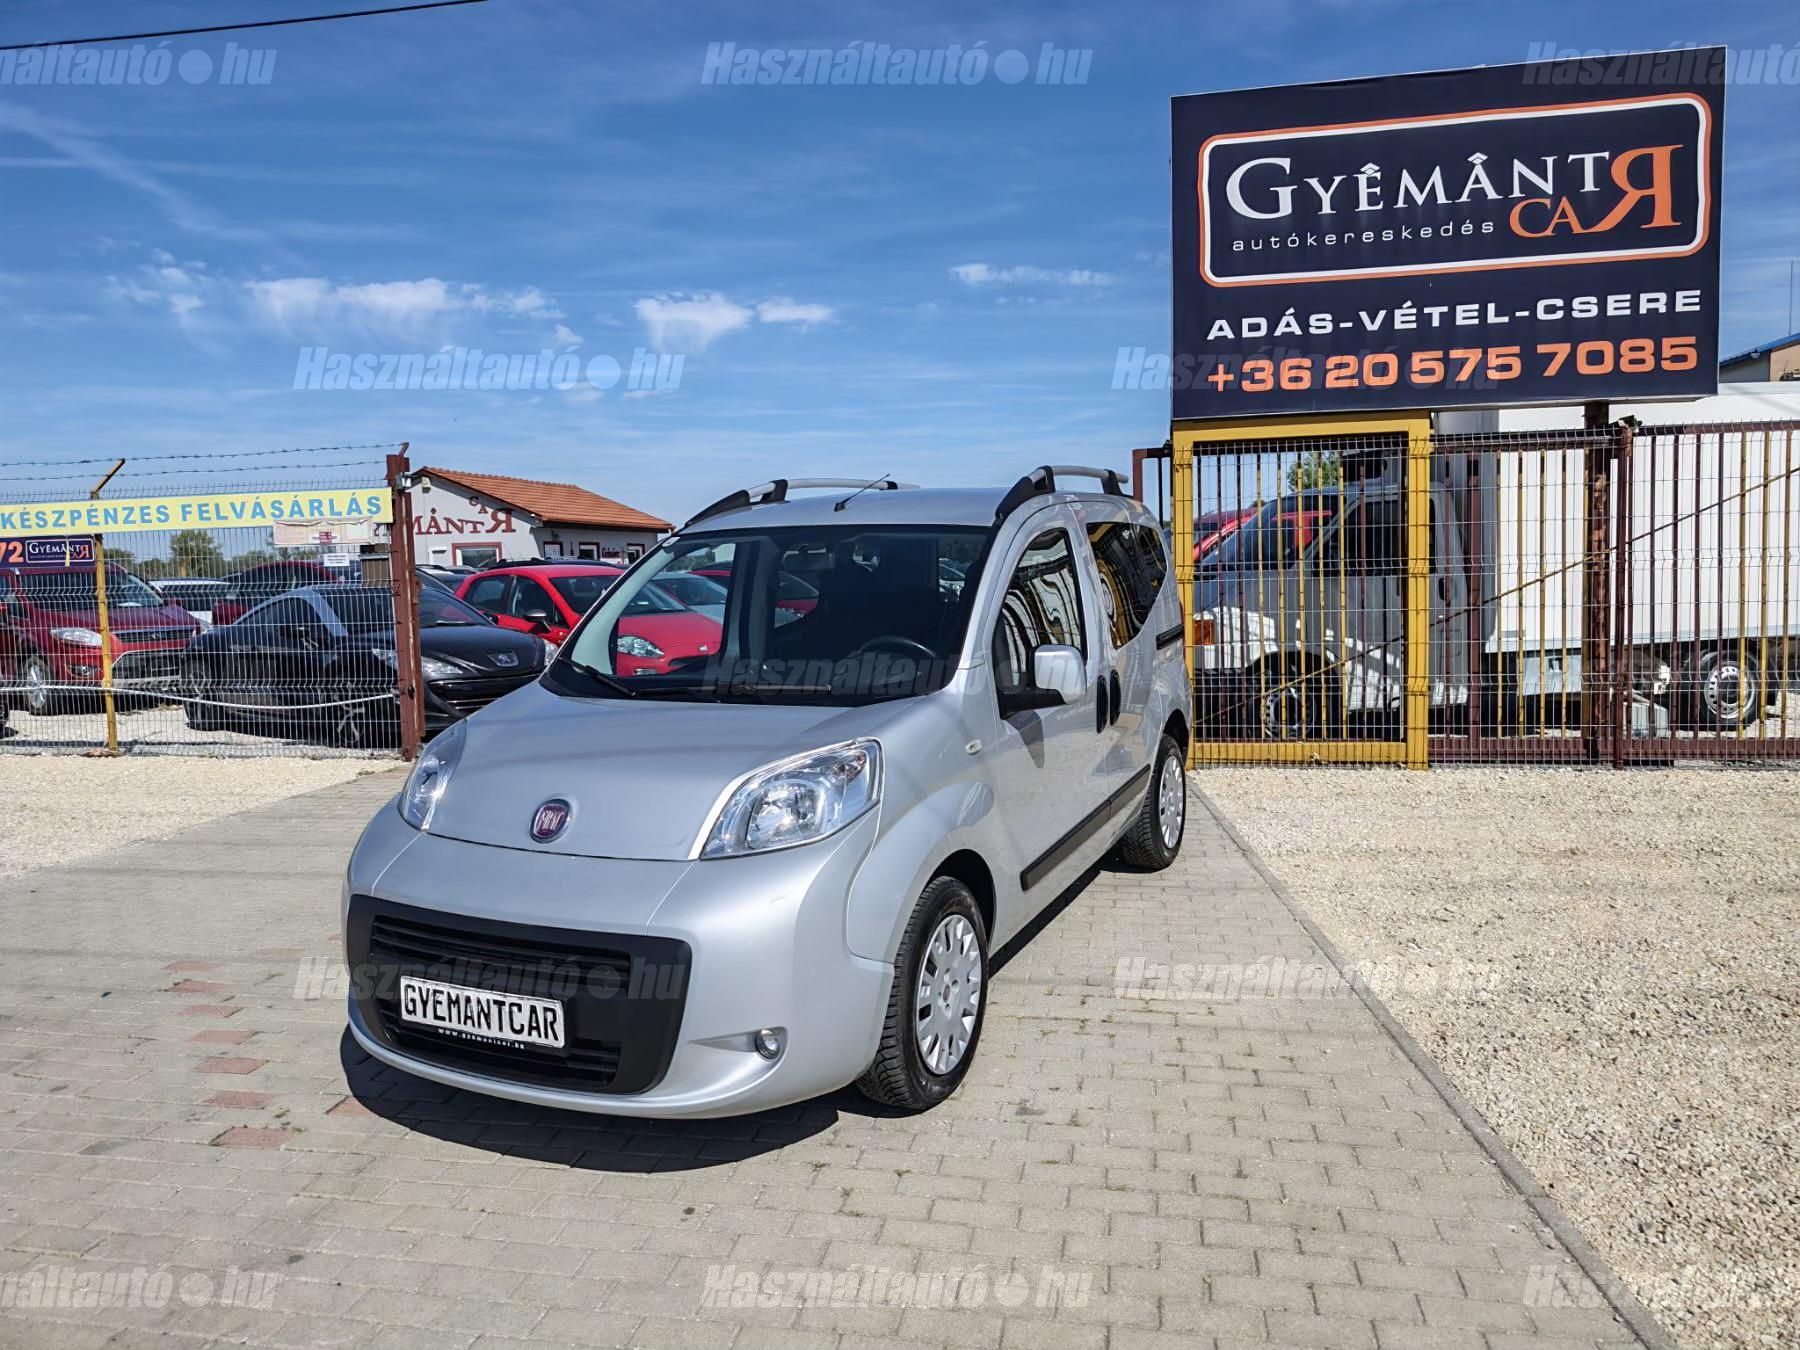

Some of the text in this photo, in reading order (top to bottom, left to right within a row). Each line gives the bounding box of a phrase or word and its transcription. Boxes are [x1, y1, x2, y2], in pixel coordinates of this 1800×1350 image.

[1232, 219, 1495, 251] autókereskedés
[1206, 290, 1701, 340] ADÁS-VÉTEL-CSERE
[1207, 336, 1698, 392] +36 20 575 7085
[1, 492, 382, 530] KÉSZPÉNZES FELVÁSÁRLÁS
[403, 983, 560, 1042] GYEMANTCAR
